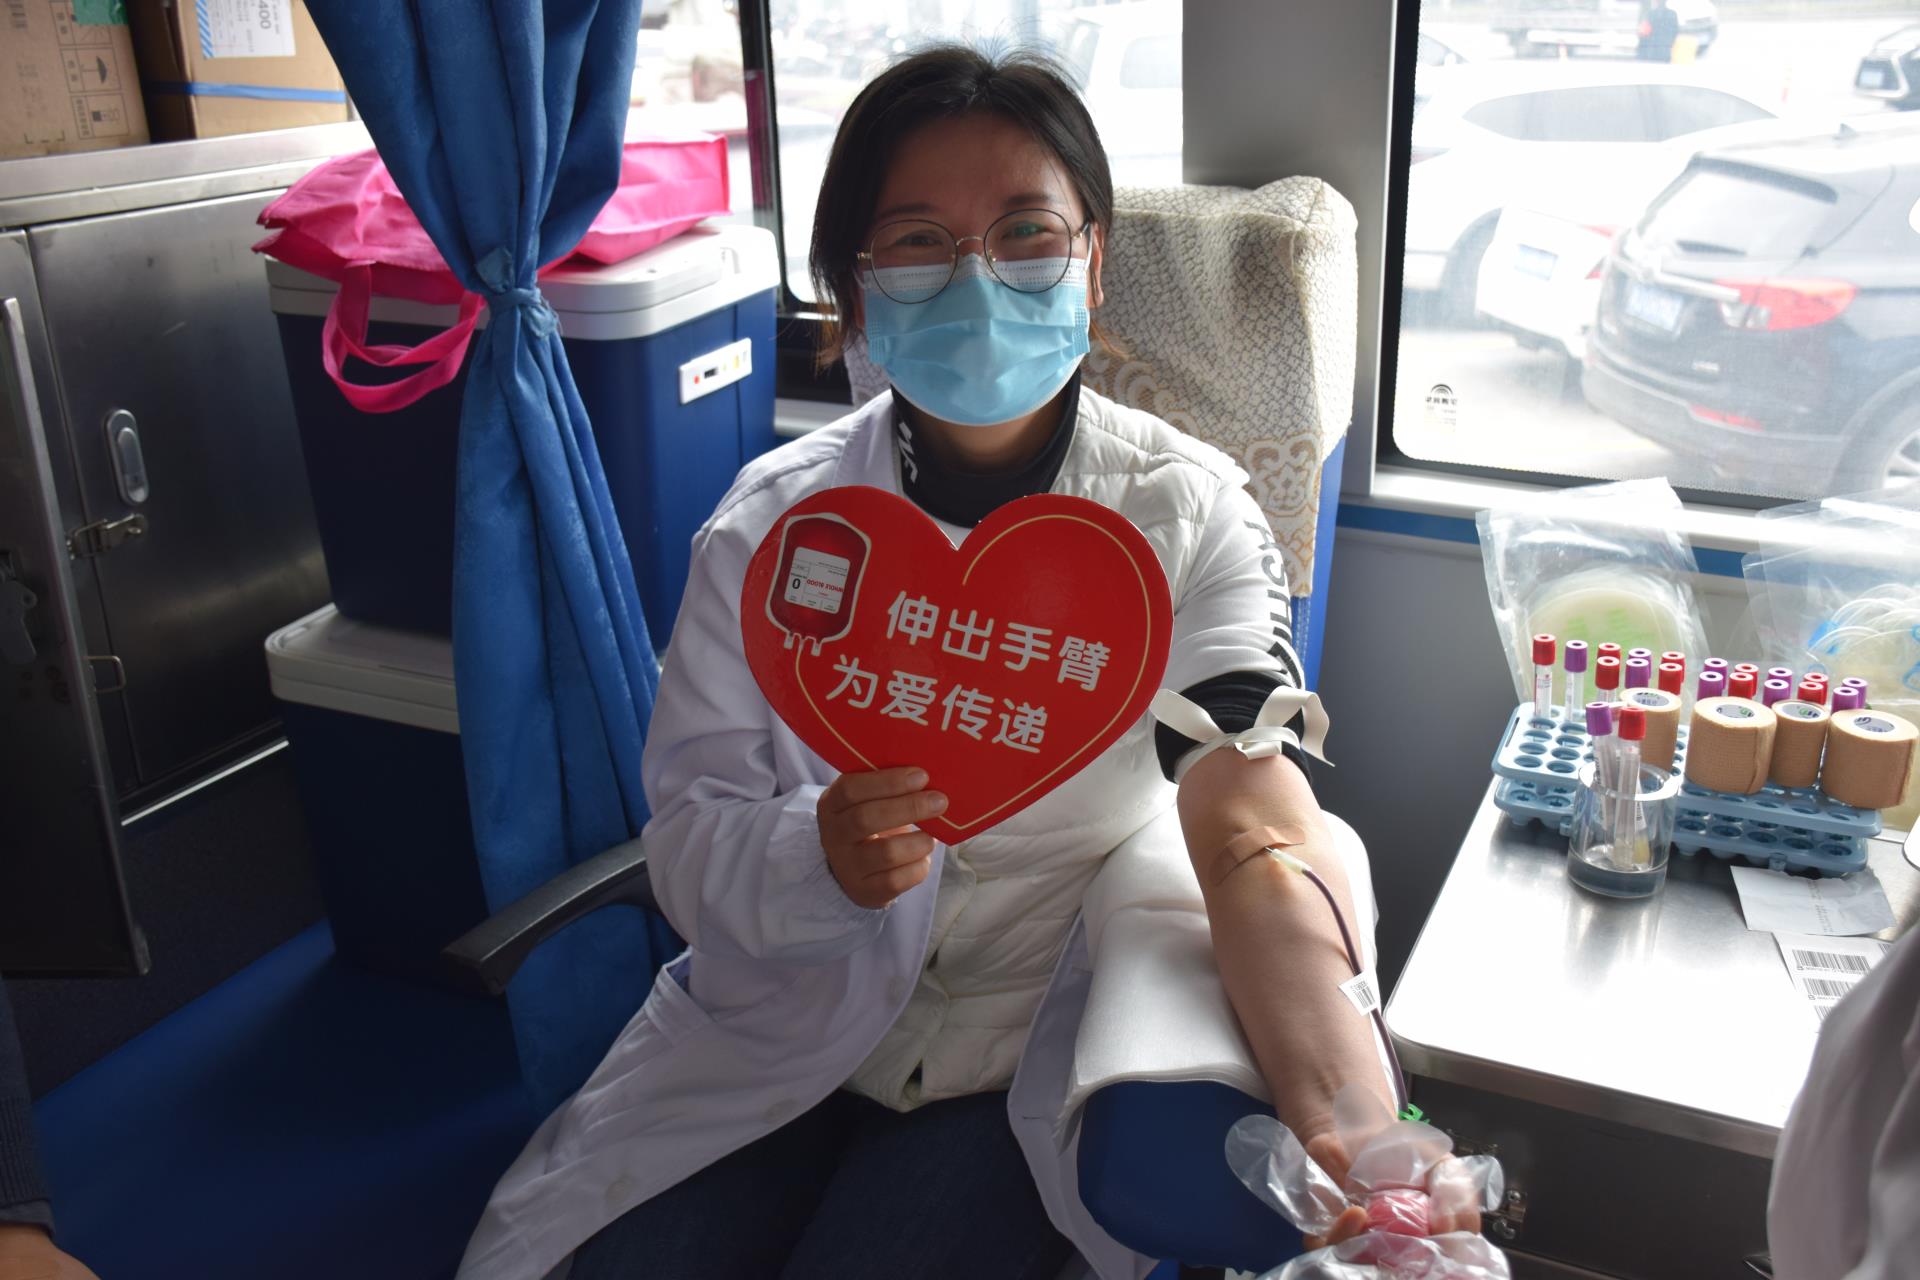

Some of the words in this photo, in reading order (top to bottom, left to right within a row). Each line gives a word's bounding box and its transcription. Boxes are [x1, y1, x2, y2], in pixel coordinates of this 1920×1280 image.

[887, 591, 1111, 692] 伸出手臂
[826, 654, 1048, 753] 为爱传递
